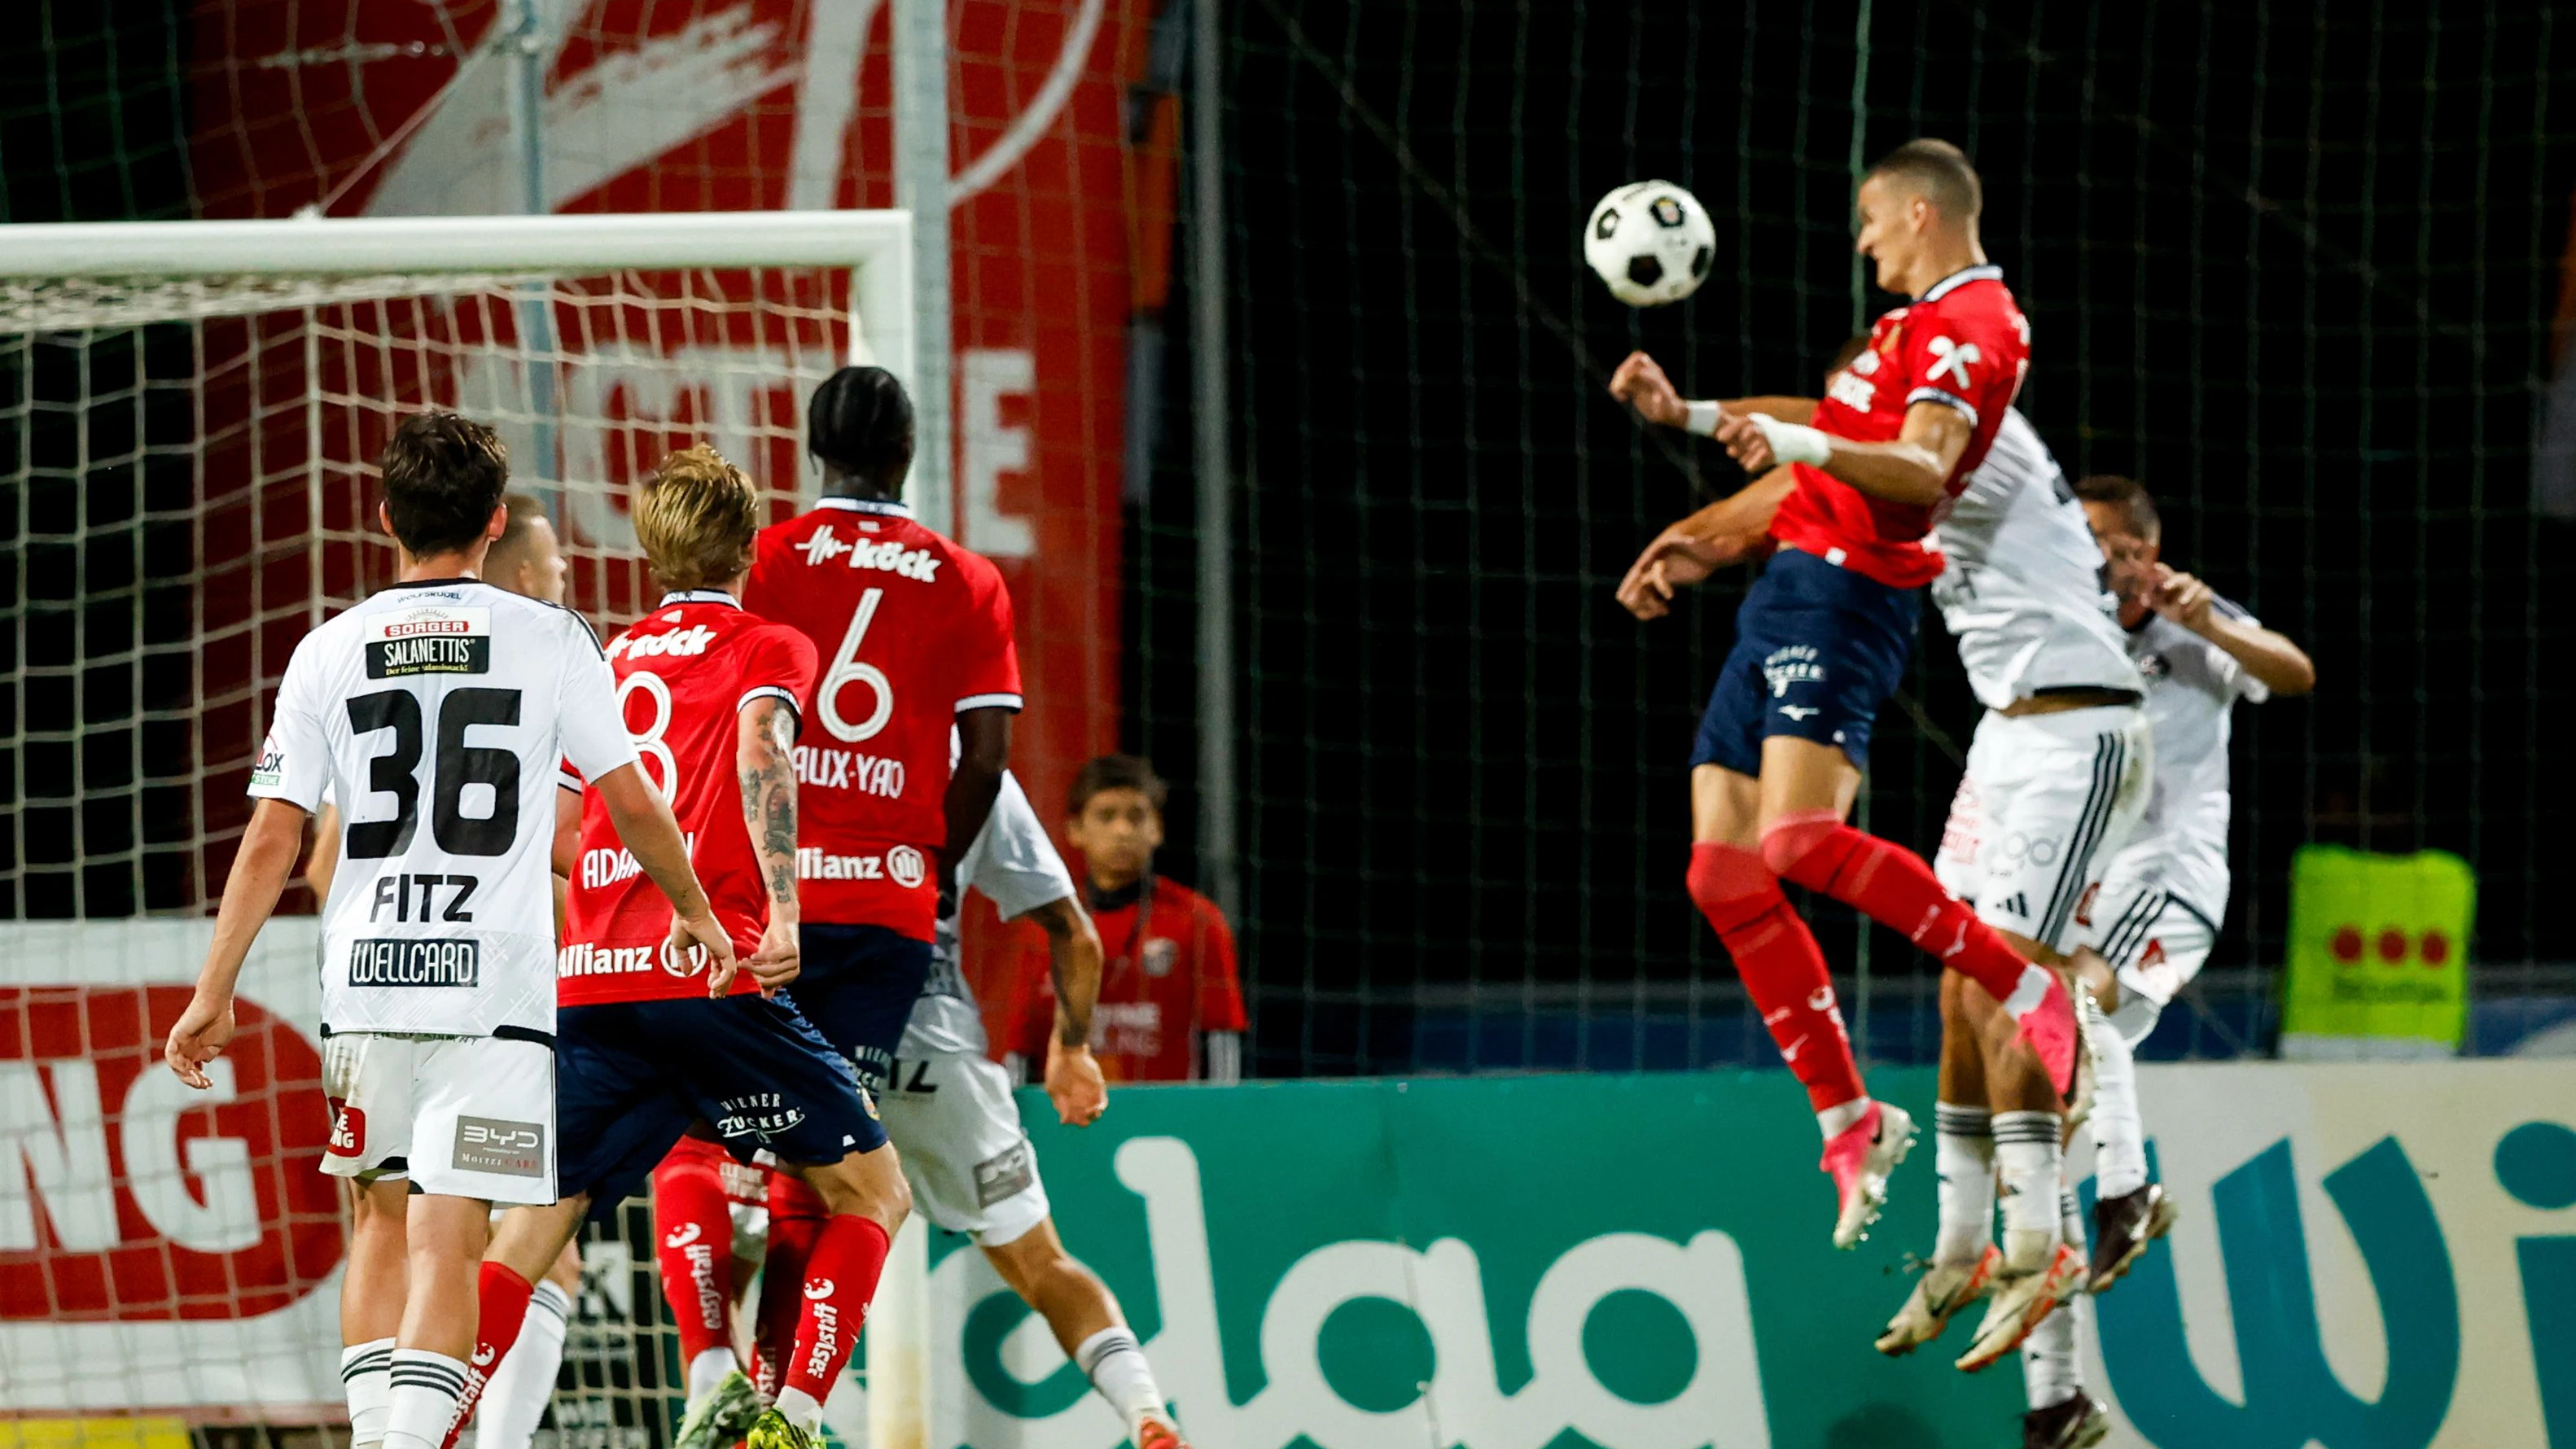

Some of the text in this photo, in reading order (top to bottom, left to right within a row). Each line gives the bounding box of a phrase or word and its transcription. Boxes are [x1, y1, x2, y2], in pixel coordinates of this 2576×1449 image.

[389, 622, 464, 636] SORGER
[817, 588, 893, 742] 6
[616, 671, 677, 808] 8
[346, 687, 522, 860] 36
[794, 745, 905, 799] AUX-YAO
[795, 847, 883, 880] llianz
[370, 874, 479, 923] FITZ
[353, 942, 474, 984] WELLCARD
[717, 1108, 805, 1138] ZUCKER
[721, 1092, 780, 1112] WIENER
[463, 1125, 538, 1148] BYD
